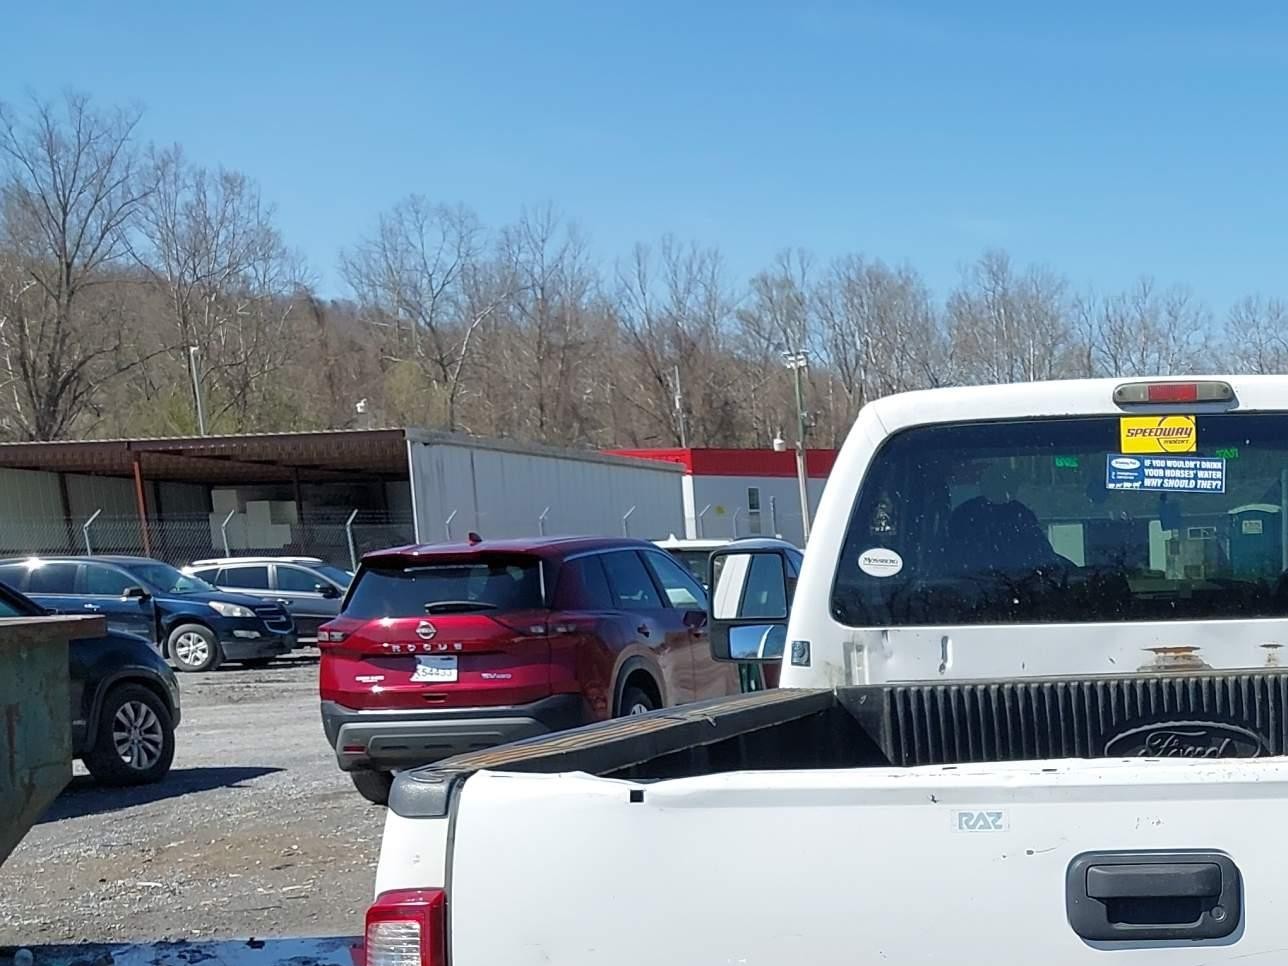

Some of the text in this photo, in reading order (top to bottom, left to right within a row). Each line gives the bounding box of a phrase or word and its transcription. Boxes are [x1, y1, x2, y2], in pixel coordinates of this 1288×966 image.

[1126, 426, 1193, 439] SPEEDWAY
[1144, 459, 1151, 467] IF
[1152, 459, 1165, 467] YOU
[1166, 460, 1200, 468] WOULDN'T
[1201, 461, 1222, 469] DRINK
[1144, 469, 1163, 477] YOUR
[1198, 470, 1222, 479] WATER
[1144, 478, 1222, 489] WHY SHOULD THEY?
[1138, 731, 1231, 757] Ford
[959, 812, 1003, 829] RAZ
